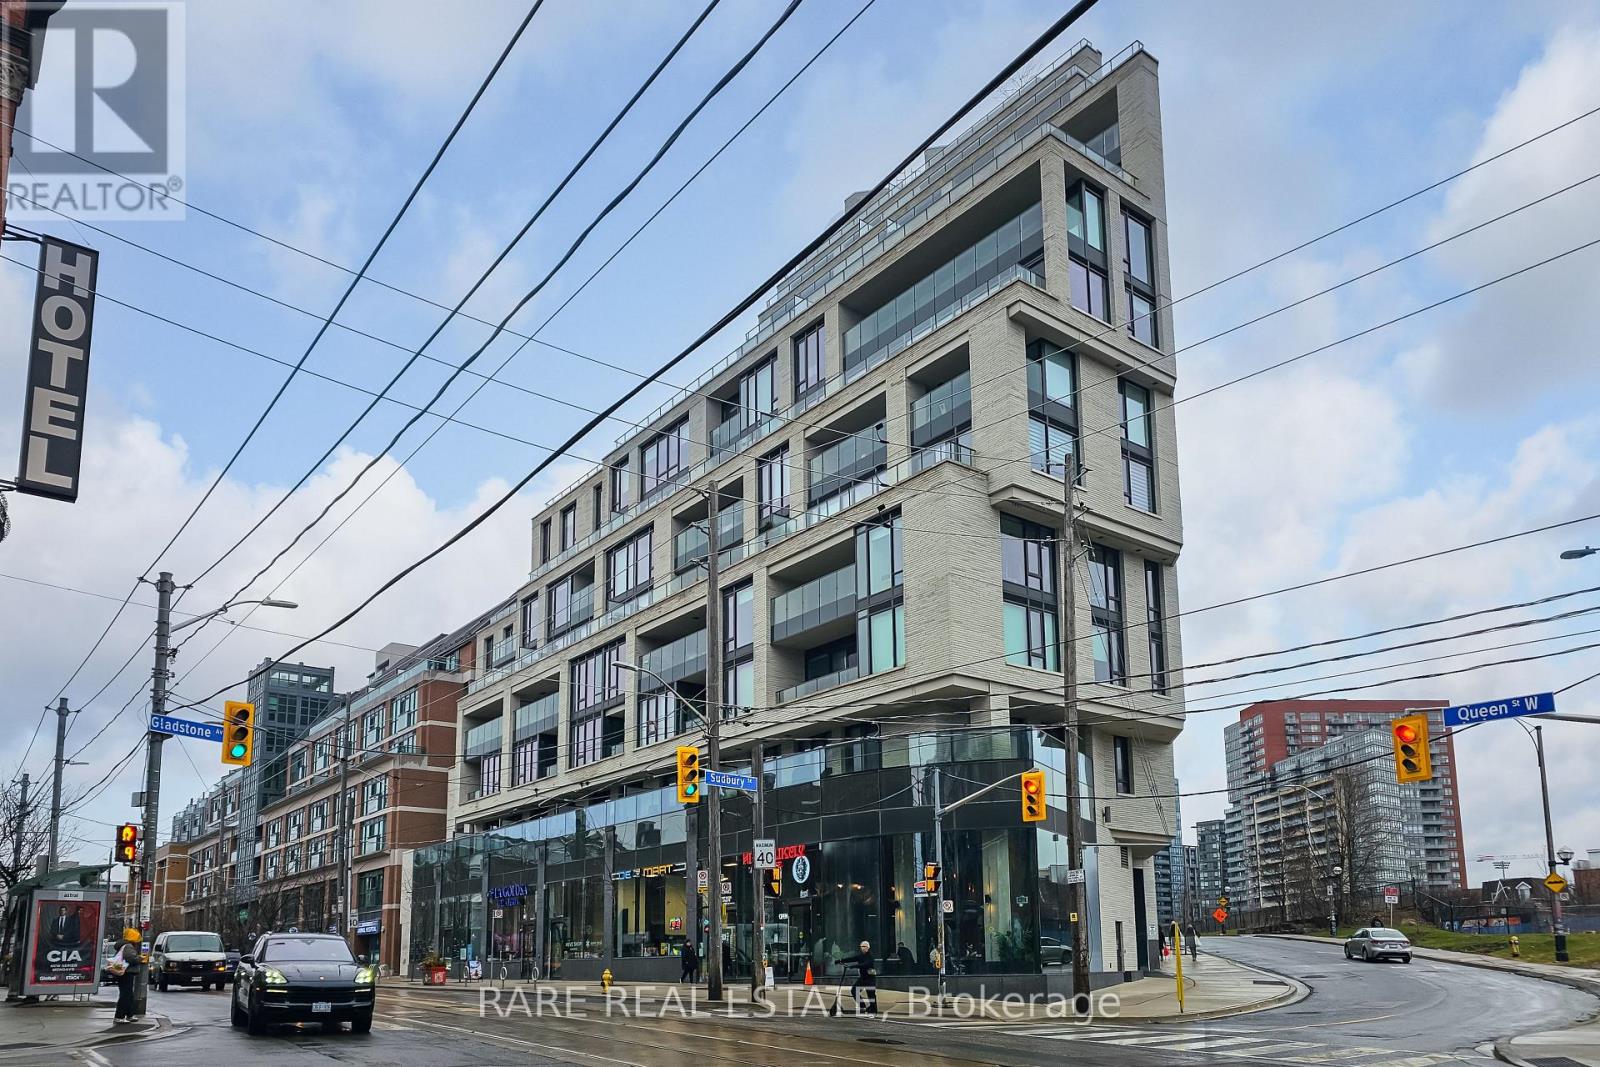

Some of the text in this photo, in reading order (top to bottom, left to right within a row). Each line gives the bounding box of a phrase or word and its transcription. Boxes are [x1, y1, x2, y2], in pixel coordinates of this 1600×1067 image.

[25, 243, 92, 489] HOTEL
[1457, 696, 1538, 721] Queen St W
[151, 716, 211, 738] Gladstone
[710, 773, 745, 788] Sudbury
[757, 851, 774, 865] 40
[46, 950, 82, 962] CIA
